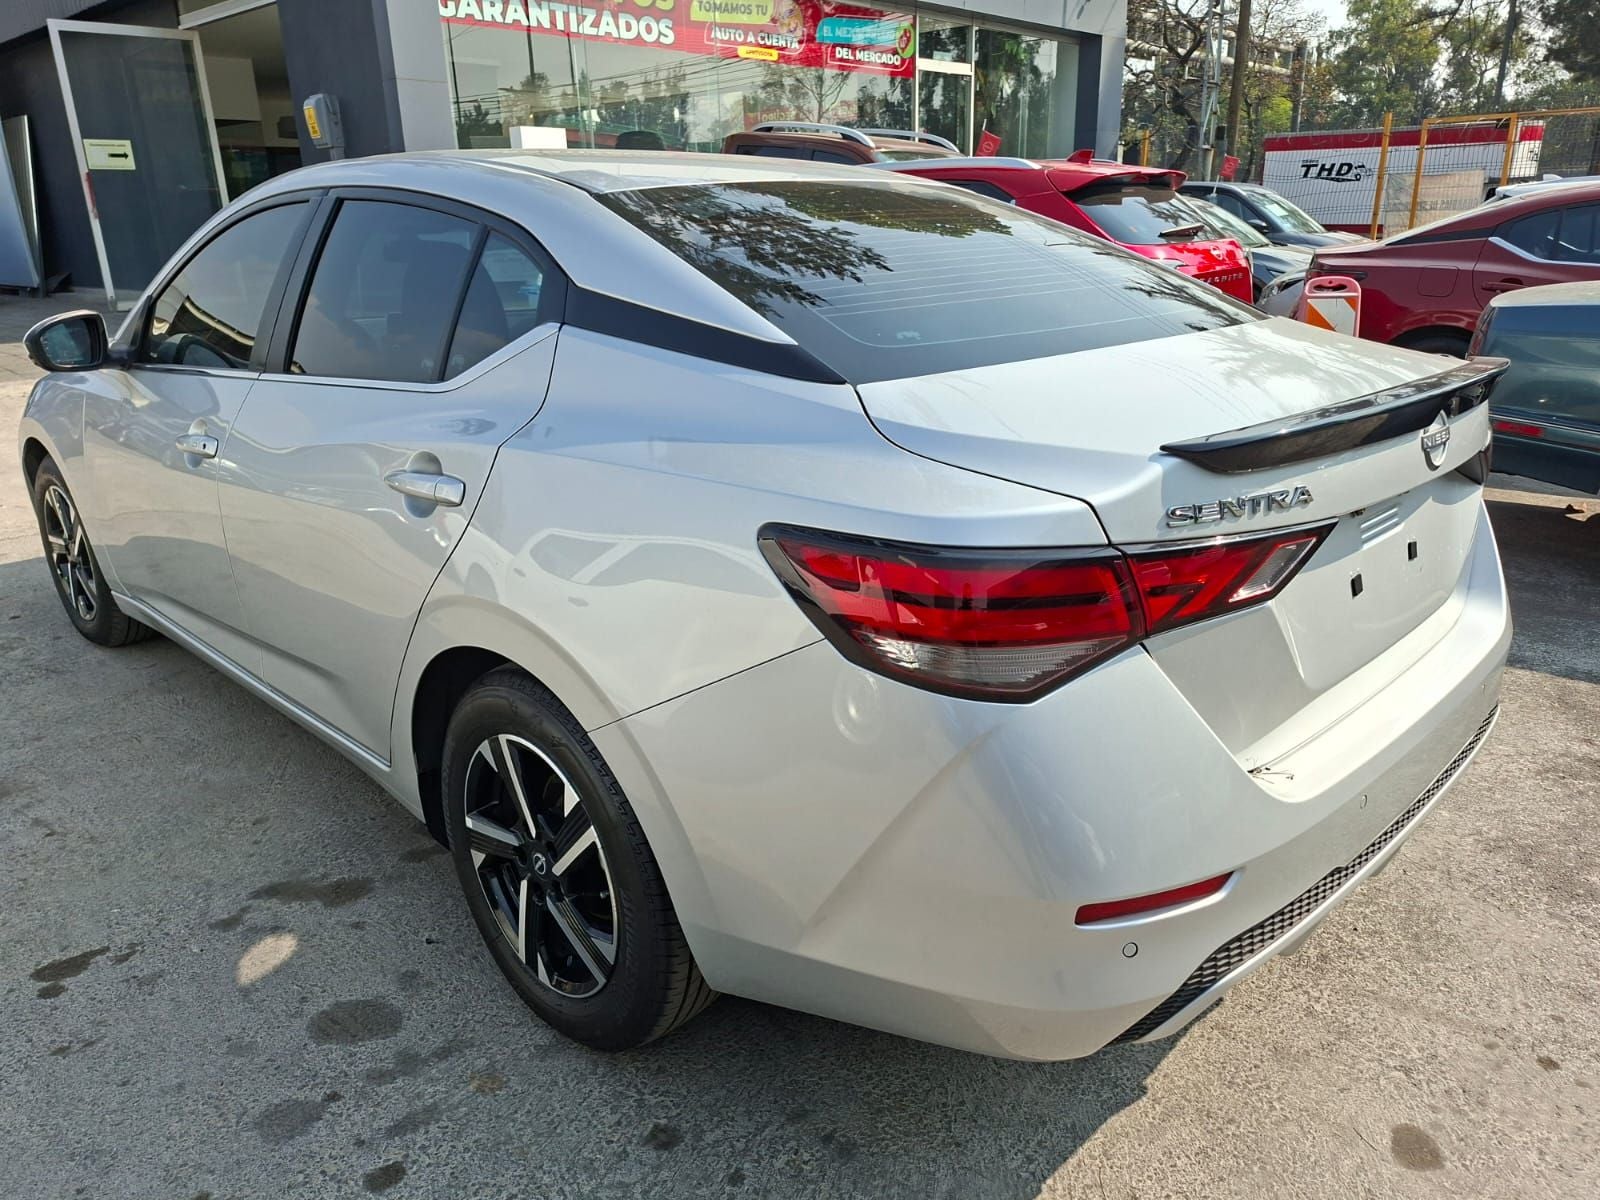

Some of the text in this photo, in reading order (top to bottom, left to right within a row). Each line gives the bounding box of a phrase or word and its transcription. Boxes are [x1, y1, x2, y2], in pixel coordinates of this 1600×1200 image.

[698, 0, 768, 16] TOMAMOS TU
[711, 25, 800, 49] AUTO A CUENTA
[835, 46, 901, 66] DEL MERCADO
[1301, 162, 1353, 178] THD
[1166, 484, 1314, 528] SENTRA
